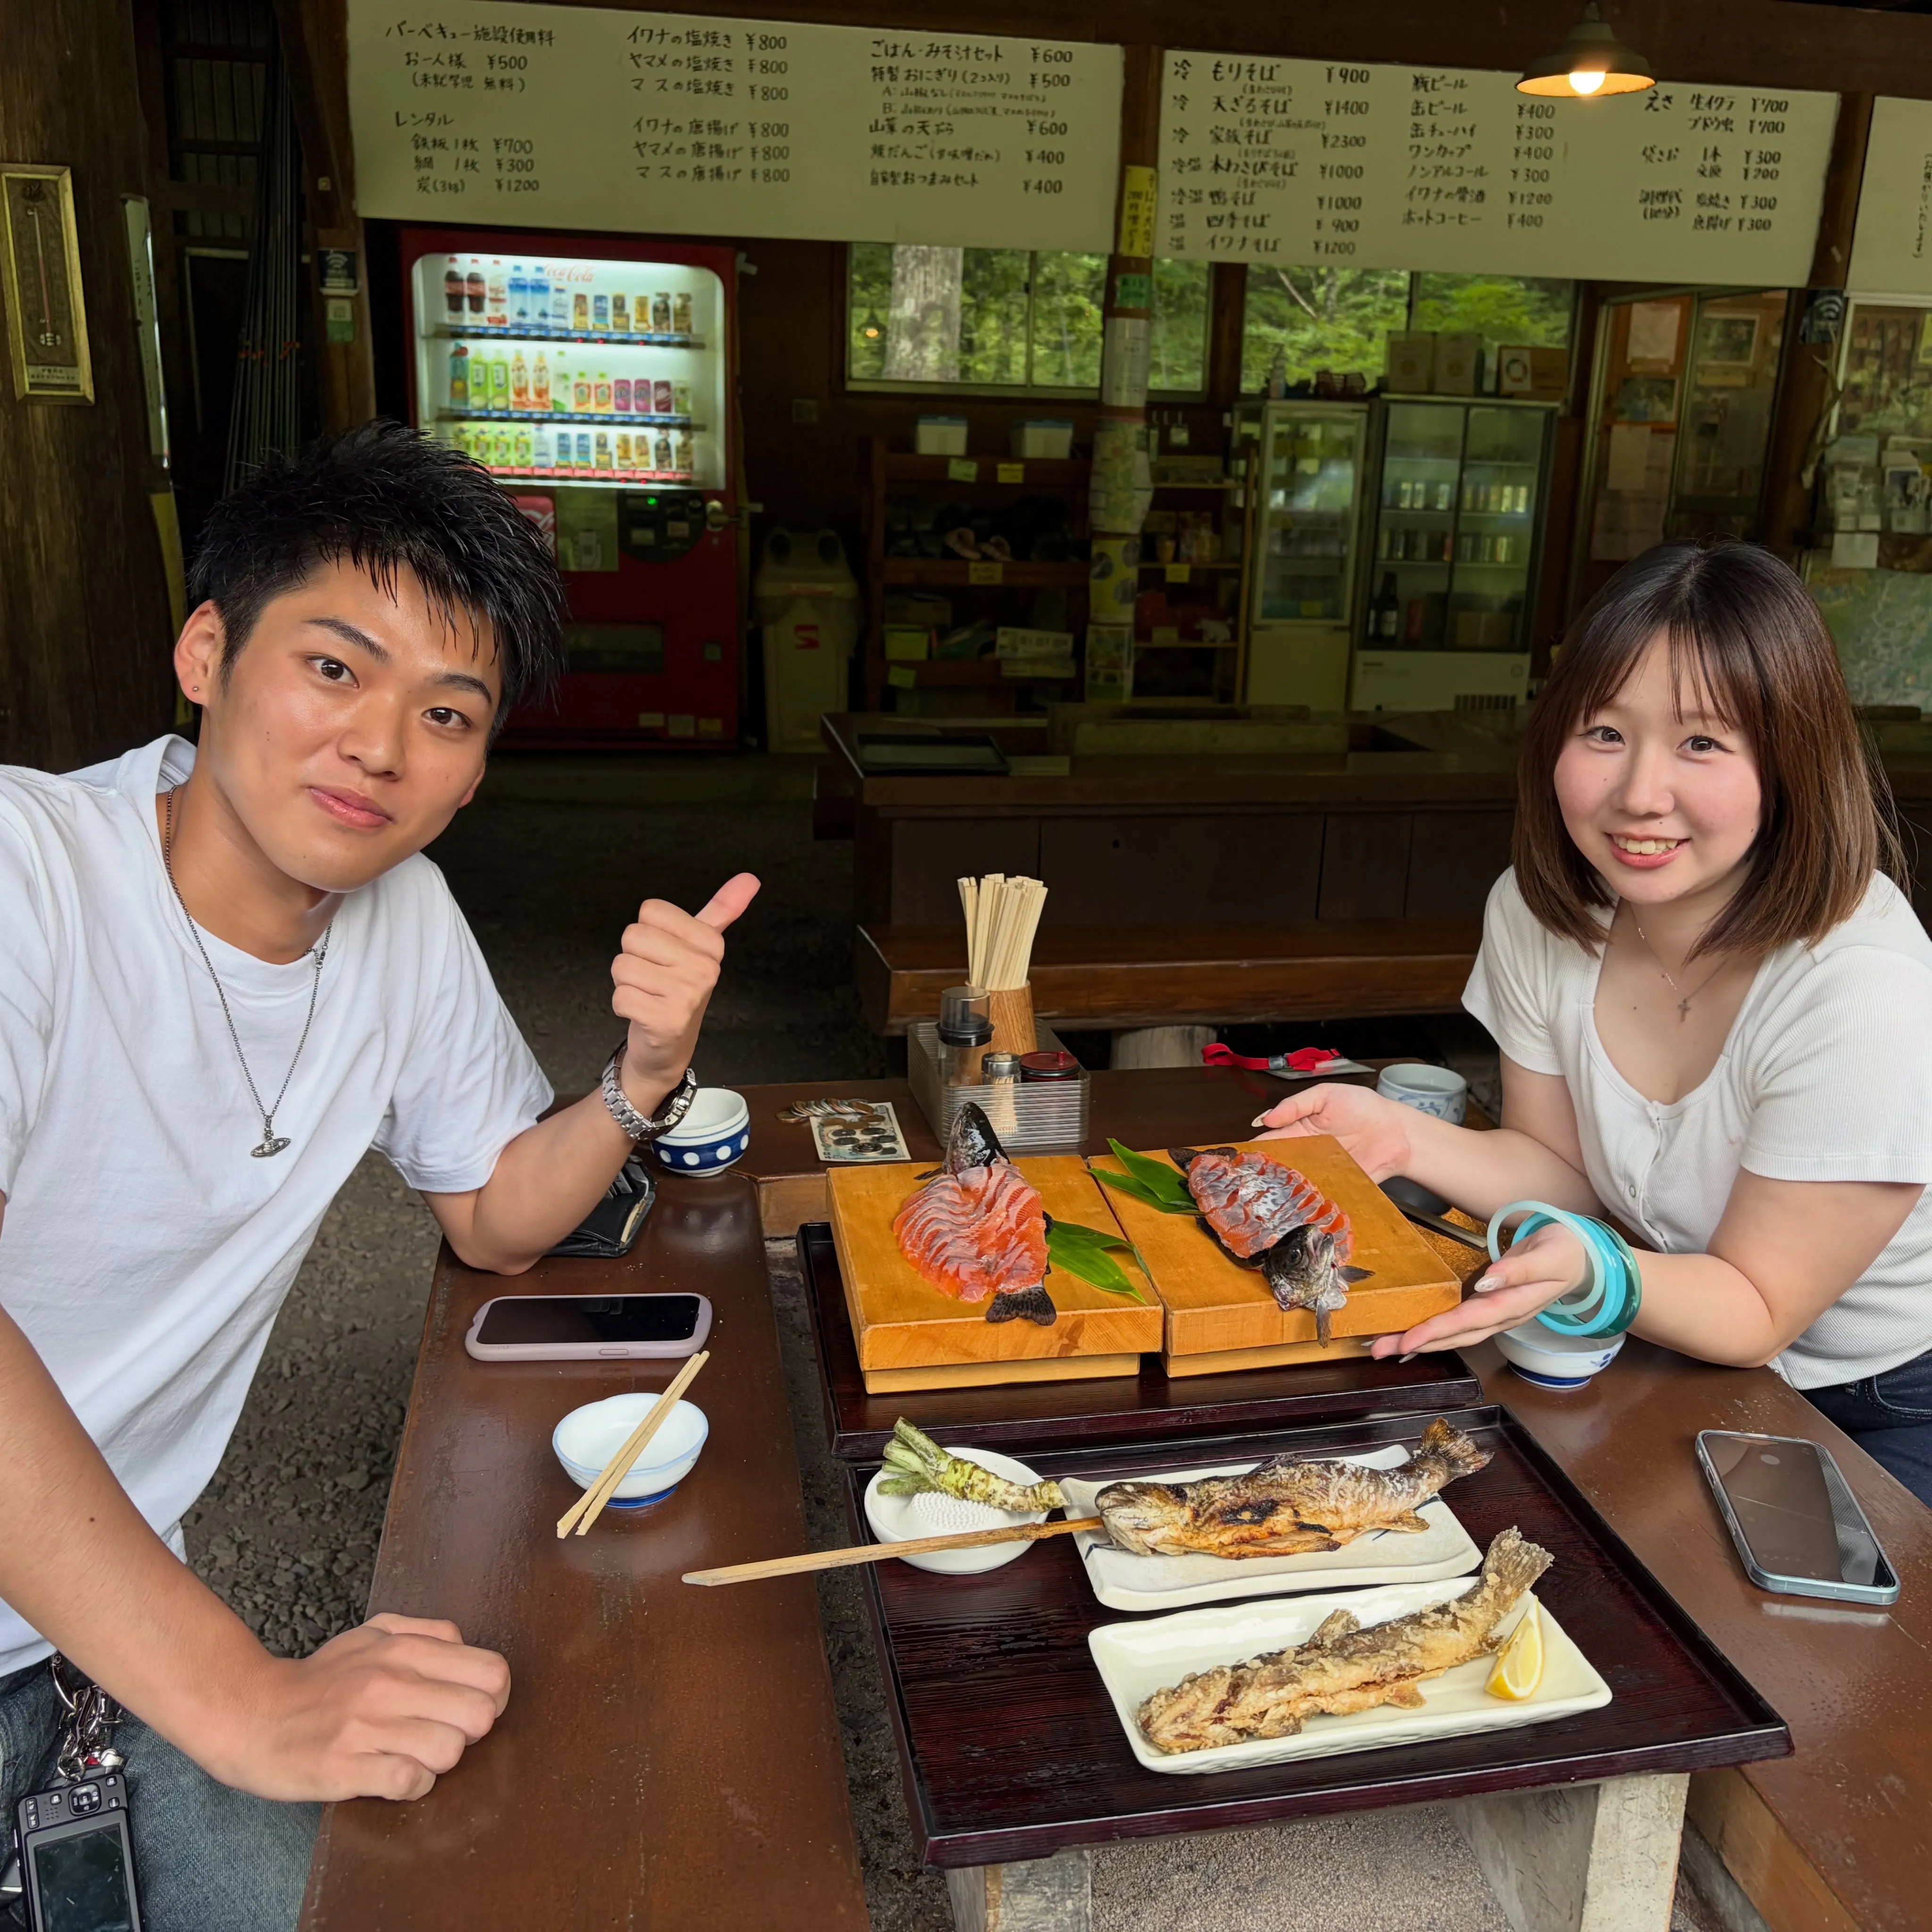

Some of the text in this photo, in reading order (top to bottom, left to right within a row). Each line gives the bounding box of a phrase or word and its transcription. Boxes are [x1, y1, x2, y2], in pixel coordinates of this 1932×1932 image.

[386, 20, 555, 46] バーベキュー施設使用料
[627, 26, 787, 51] イワナの塩焼き ¥800
[405, 52, 527, 70] お一人様 ¥500
[630, 52, 788, 74] ヤマメの塩焼き ¥800
[1031, 48, 1073, 63] ¥600
[1174, 59, 1370, 83] 冷 もりそば ¥900
[1030, 73, 1070, 88] ¥500
[749, 84, 788, 101] ¥800
[1173, 94, 1189, 111] 冷
[1325, 100, 1369, 115] ¥1400
[1411, 99, 1555, 119] 缶ビール ¥400
[1645, 90, 1789, 113] えさ 生イクラ ¥700
[396, 111, 454, 127] レンタル
[1749, 120, 1785, 134] ¥700
[633, 117, 789, 139] イワナの唐揚げ ¥800
[1027, 120, 1067, 135] ¥600
[1410, 122, 1554, 140] 缶チューハイ ¥300
[493, 138, 533, 154] ¥700
[1173, 127, 1189, 143] 冷
[1322, 133, 1366, 149] ¥2300
[633, 141, 790, 161] ヤマメの唐揚げ ¥800
[1025, 150, 1065, 164] ¥400
[1409, 144, 1553, 160] ワンカップ ¥400
[1745, 150, 1781, 165] ¥300
[455, 158, 479, 173] 1枚
[496, 158, 534, 173] ¥300
[1320, 164, 1364, 179] ¥1000
[751, 168, 790, 183] ¥800
[1408, 165, 1549, 183] ノンアルコール ¥300
[495, 178, 539, 192] ¥1200
[1024, 180, 1062, 194] ¥400
[1317, 197, 1362, 210] ¥1000
[1508, 192, 1552, 205] ¥1200
[1741, 195, 1777, 210] ¥300
[1402, 208, 1543, 228] ホットコーヒー ¥400
[1739, 217, 1772, 231] ¥300
[1207, 234, 1281, 253] イワナそば
[1313, 241, 1356, 255] ¥1200
